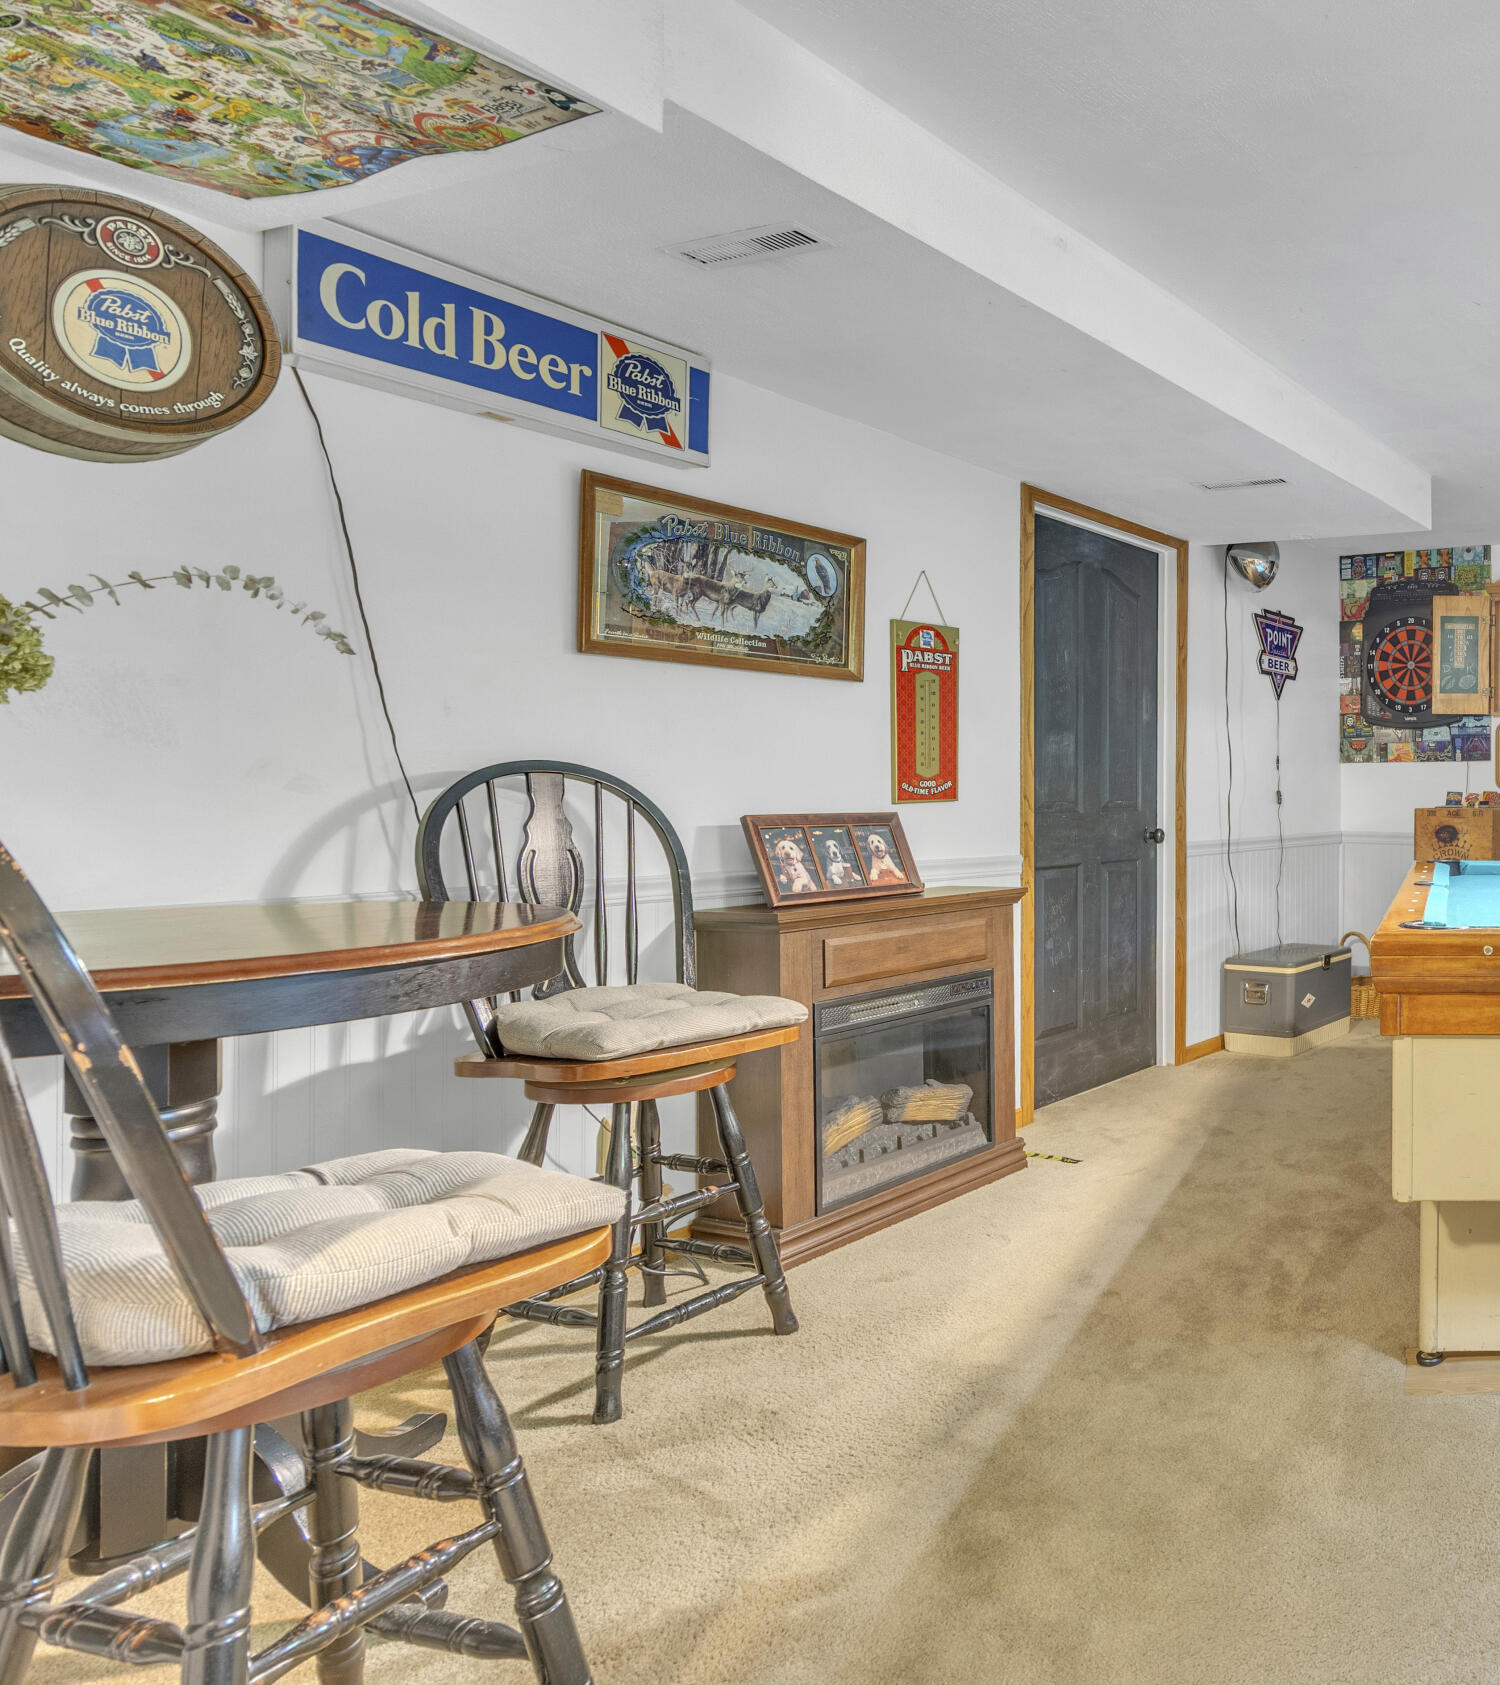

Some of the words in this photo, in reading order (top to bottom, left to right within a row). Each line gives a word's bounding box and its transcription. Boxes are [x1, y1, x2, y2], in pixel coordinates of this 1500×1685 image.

[450, 111, 475, 124] Six
[480, 101, 523, 116] Flags
[106, 221, 156, 246] PABST
[106, 241, 133, 264] SINCE
[100, 295, 151, 324] Pabst
[80, 309, 114, 330] Blue
[116, 317, 170, 345] Ribbon
[319, 262, 458, 360] Cold
[469, 306, 593, 397] Beer
[8, 338, 60, 383] Quality
[60, 380, 116, 409] always
[119, 402, 170, 415] comes
[173, 391, 224, 414] through
[624, 359, 664, 390] Pabst
[608, 376, 636, 398] Blue
[637, 386, 680, 412] Ribbon
[661, 514, 709, 538] Pabst
[714, 522, 748, 546] Blue
[751, 530, 802, 563] Ribbon
[696, 632, 729, 645] Wildlife
[730, 636, 767, 648] Collection
[1266, 627, 1293, 657] POINT
[901, 649, 953, 671] PABST
[1267, 658, 1290, 673] BEER
[919, 780, 936, 788] GOOD
[930, 780, 953, 795] FLAVOR
